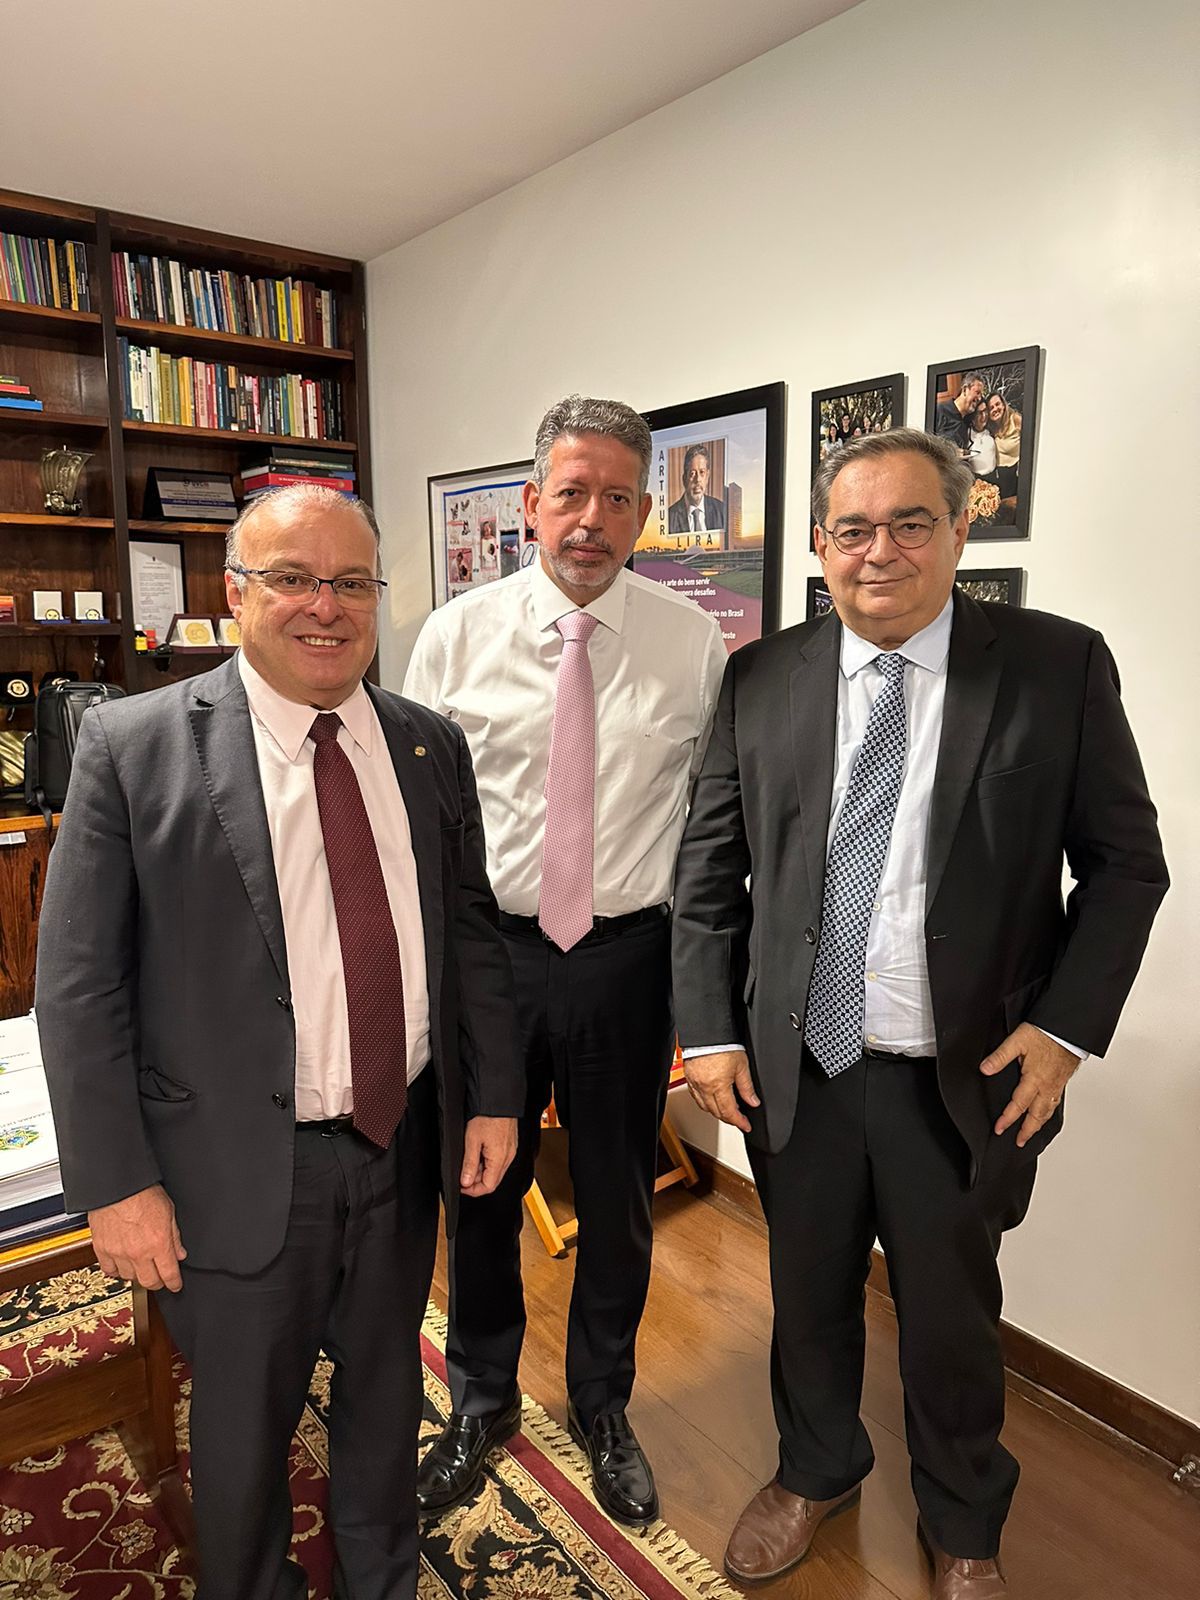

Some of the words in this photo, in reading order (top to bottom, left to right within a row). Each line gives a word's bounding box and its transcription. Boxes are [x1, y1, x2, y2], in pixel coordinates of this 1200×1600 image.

[677, 534, 713, 547] LIRA
[695, 577, 710, 585] servir
[694, 588, 716, 596] desafios
[728, 609, 743, 617] Brasil
